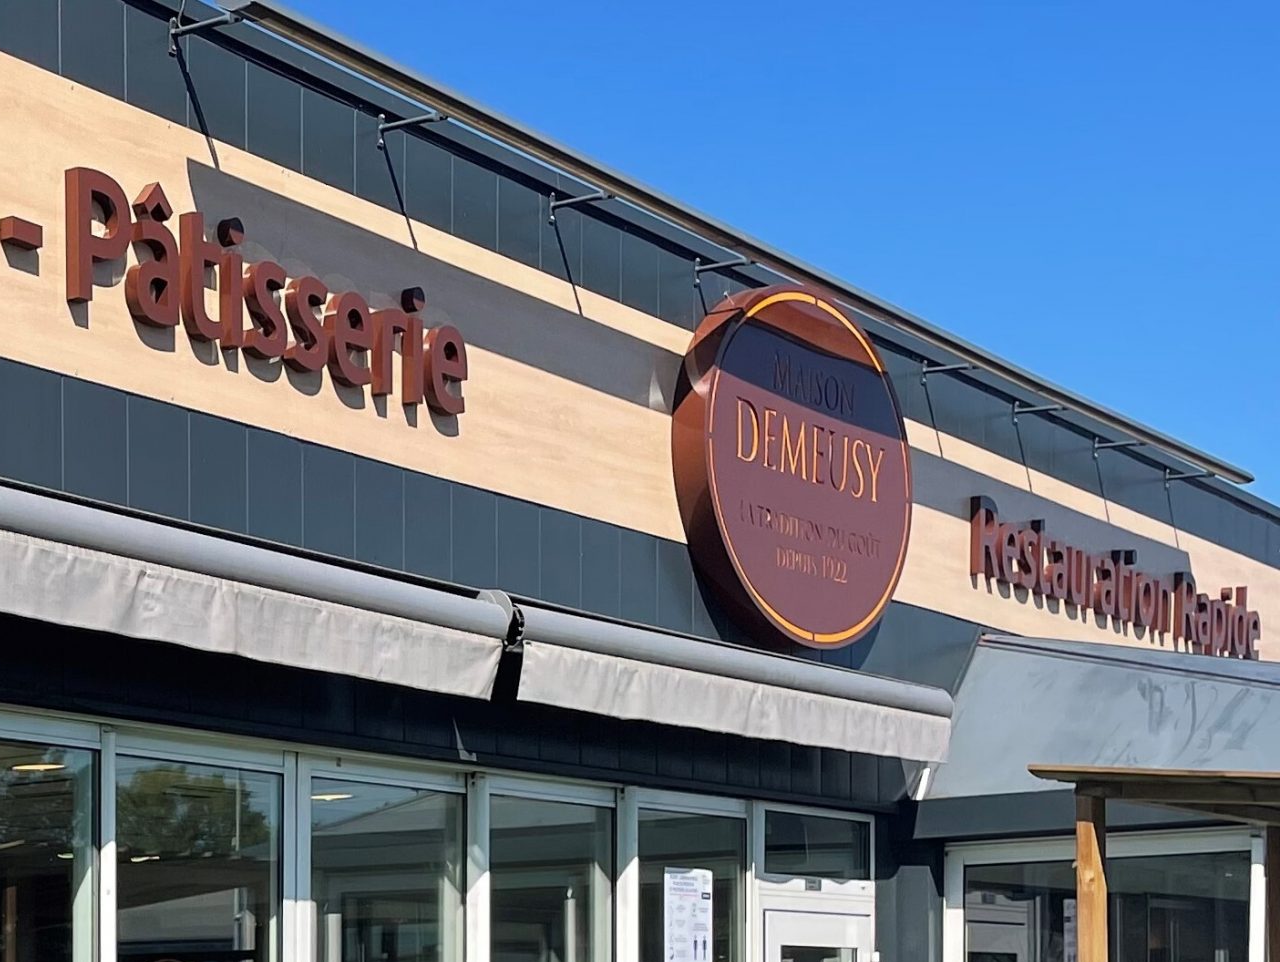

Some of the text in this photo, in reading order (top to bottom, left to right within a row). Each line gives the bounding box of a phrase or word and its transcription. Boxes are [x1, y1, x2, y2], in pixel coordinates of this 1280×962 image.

[64, 166, 467, 416] Pâtisserie
[774, 353, 856, 417] MAISON
[736, 396, 885, 502] DEMEUSY
[822, 555, 848, 584] 1922
[970, 495, 1261, 659] Restauration Rapide
